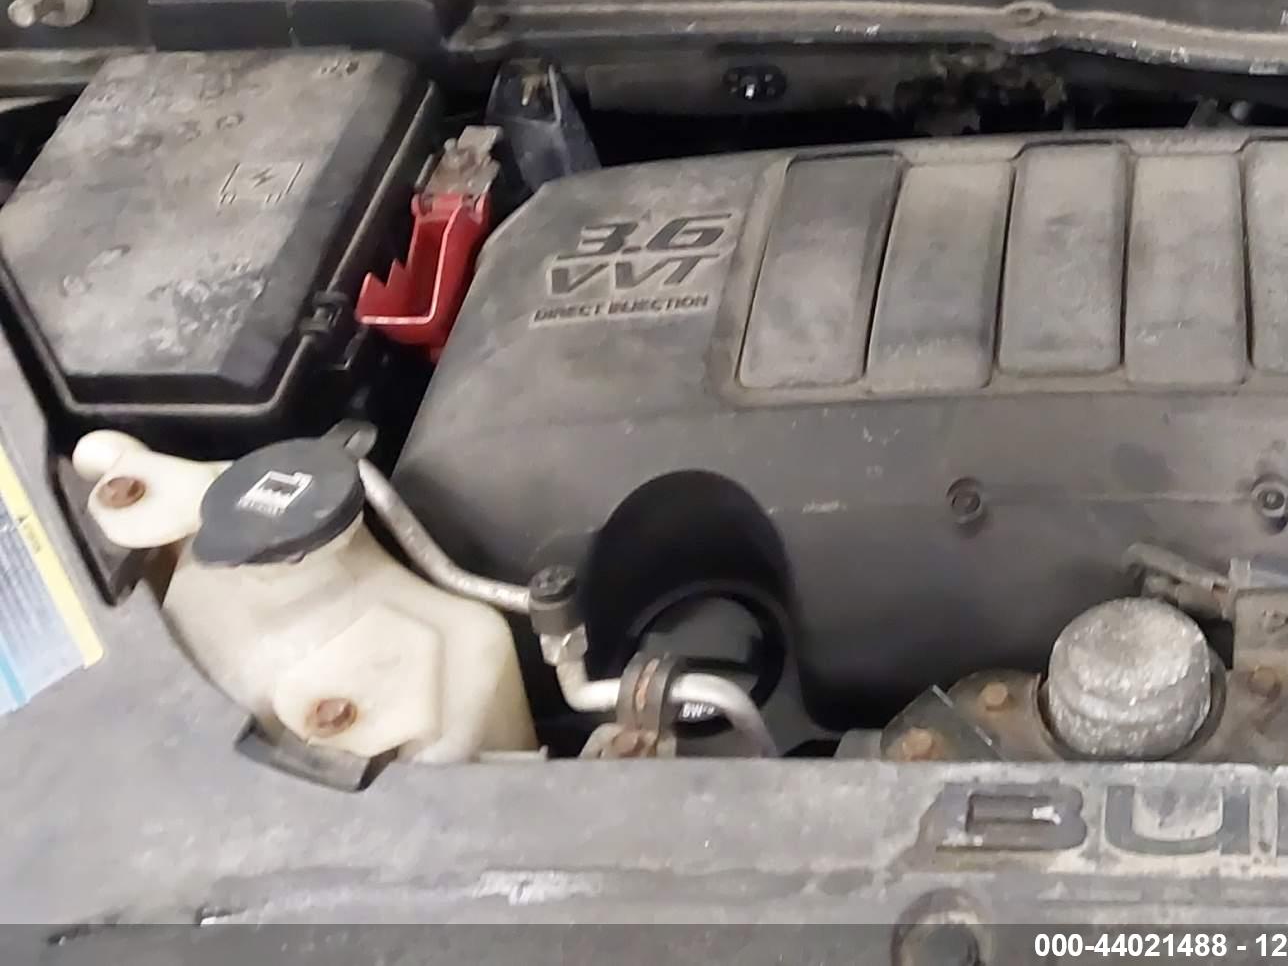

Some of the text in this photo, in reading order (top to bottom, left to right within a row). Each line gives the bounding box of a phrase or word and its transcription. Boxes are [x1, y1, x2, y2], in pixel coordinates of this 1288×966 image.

[557, 213, 734, 261] 3.6
[551, 254, 721, 295] VVT
[607, 295, 709, 315] INJECTION
